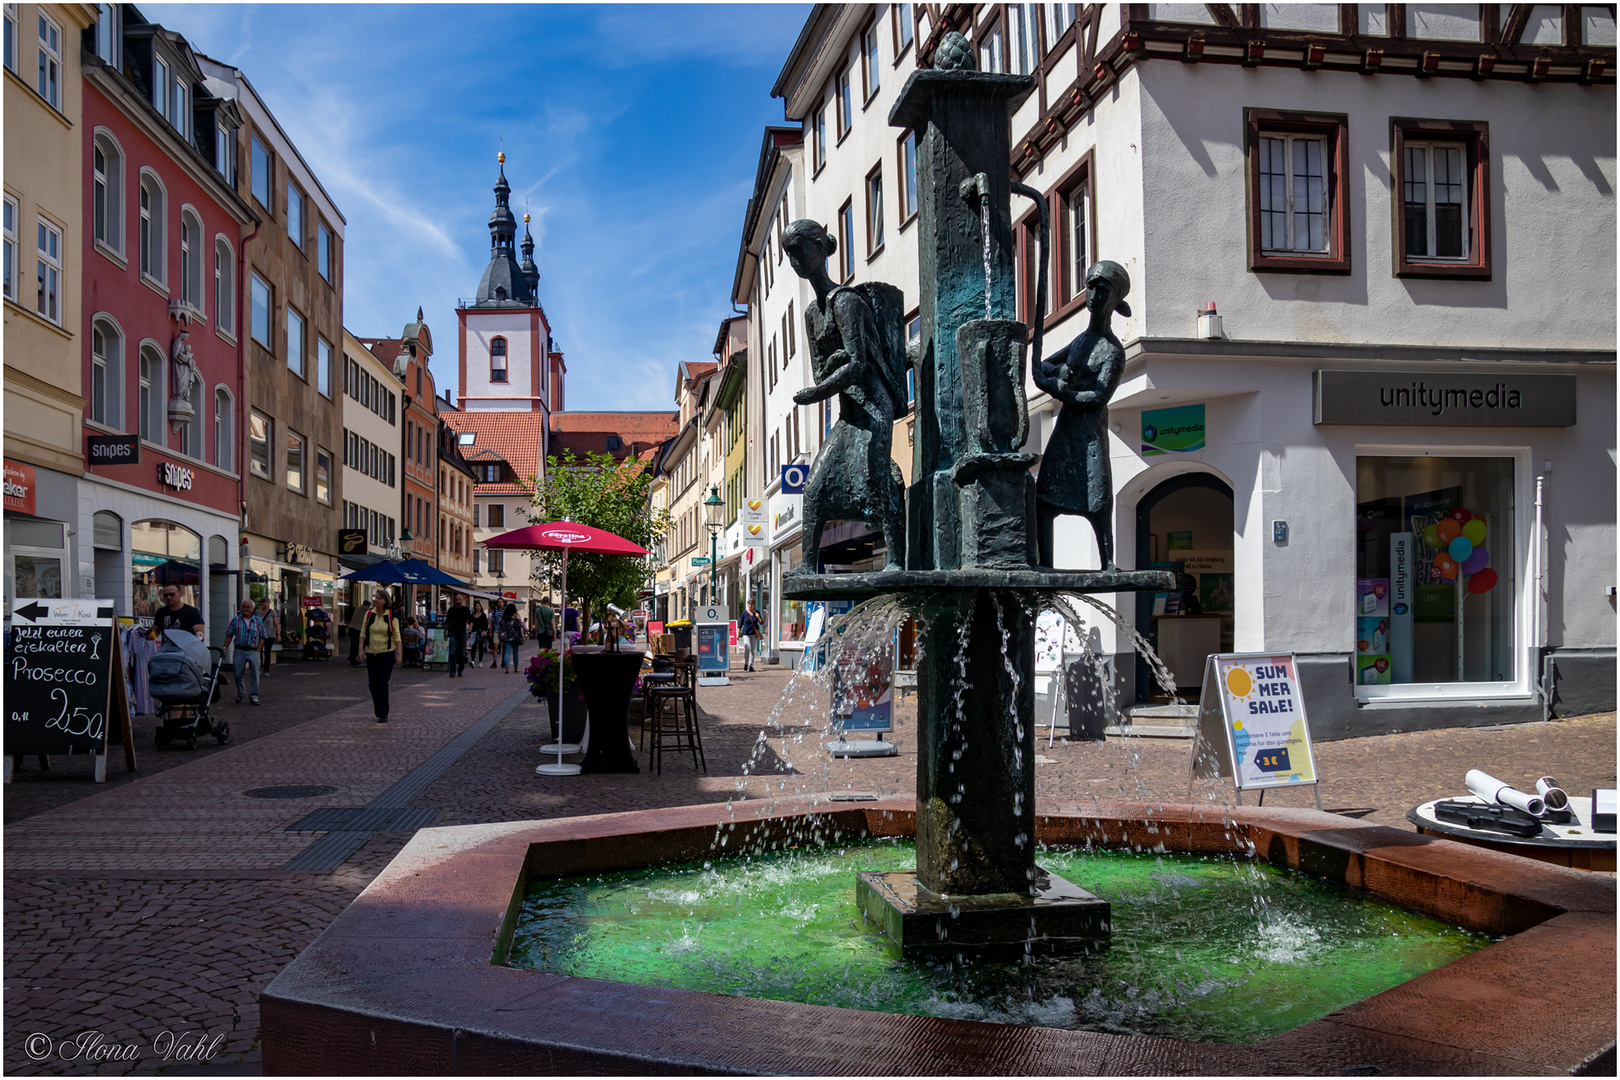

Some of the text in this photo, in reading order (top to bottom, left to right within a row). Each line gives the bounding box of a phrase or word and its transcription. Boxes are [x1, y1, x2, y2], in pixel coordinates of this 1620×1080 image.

[1380, 381, 1523, 416] unitymedia
[1159, 424, 1204, 437] unitymedia
[92, 444, 131, 459] snipes
[164, 462, 192, 491] snipes
[1395, 540, 1408, 599] unitymedia
[53, 610, 92, 618] Wein Kost
[46, 628, 84, 639] einen
[14, 640, 87, 653] eiskalten
[12, 656, 97, 686] Prosecco
[1255, 665, 1287, 680] SUM
[1258, 682, 1291, 697] MER
[1249, 699, 1294, 715] SALE!
[1235, 732, 1264, 740] kombiniere
[1276, 738, 1303, 747] günstigste
